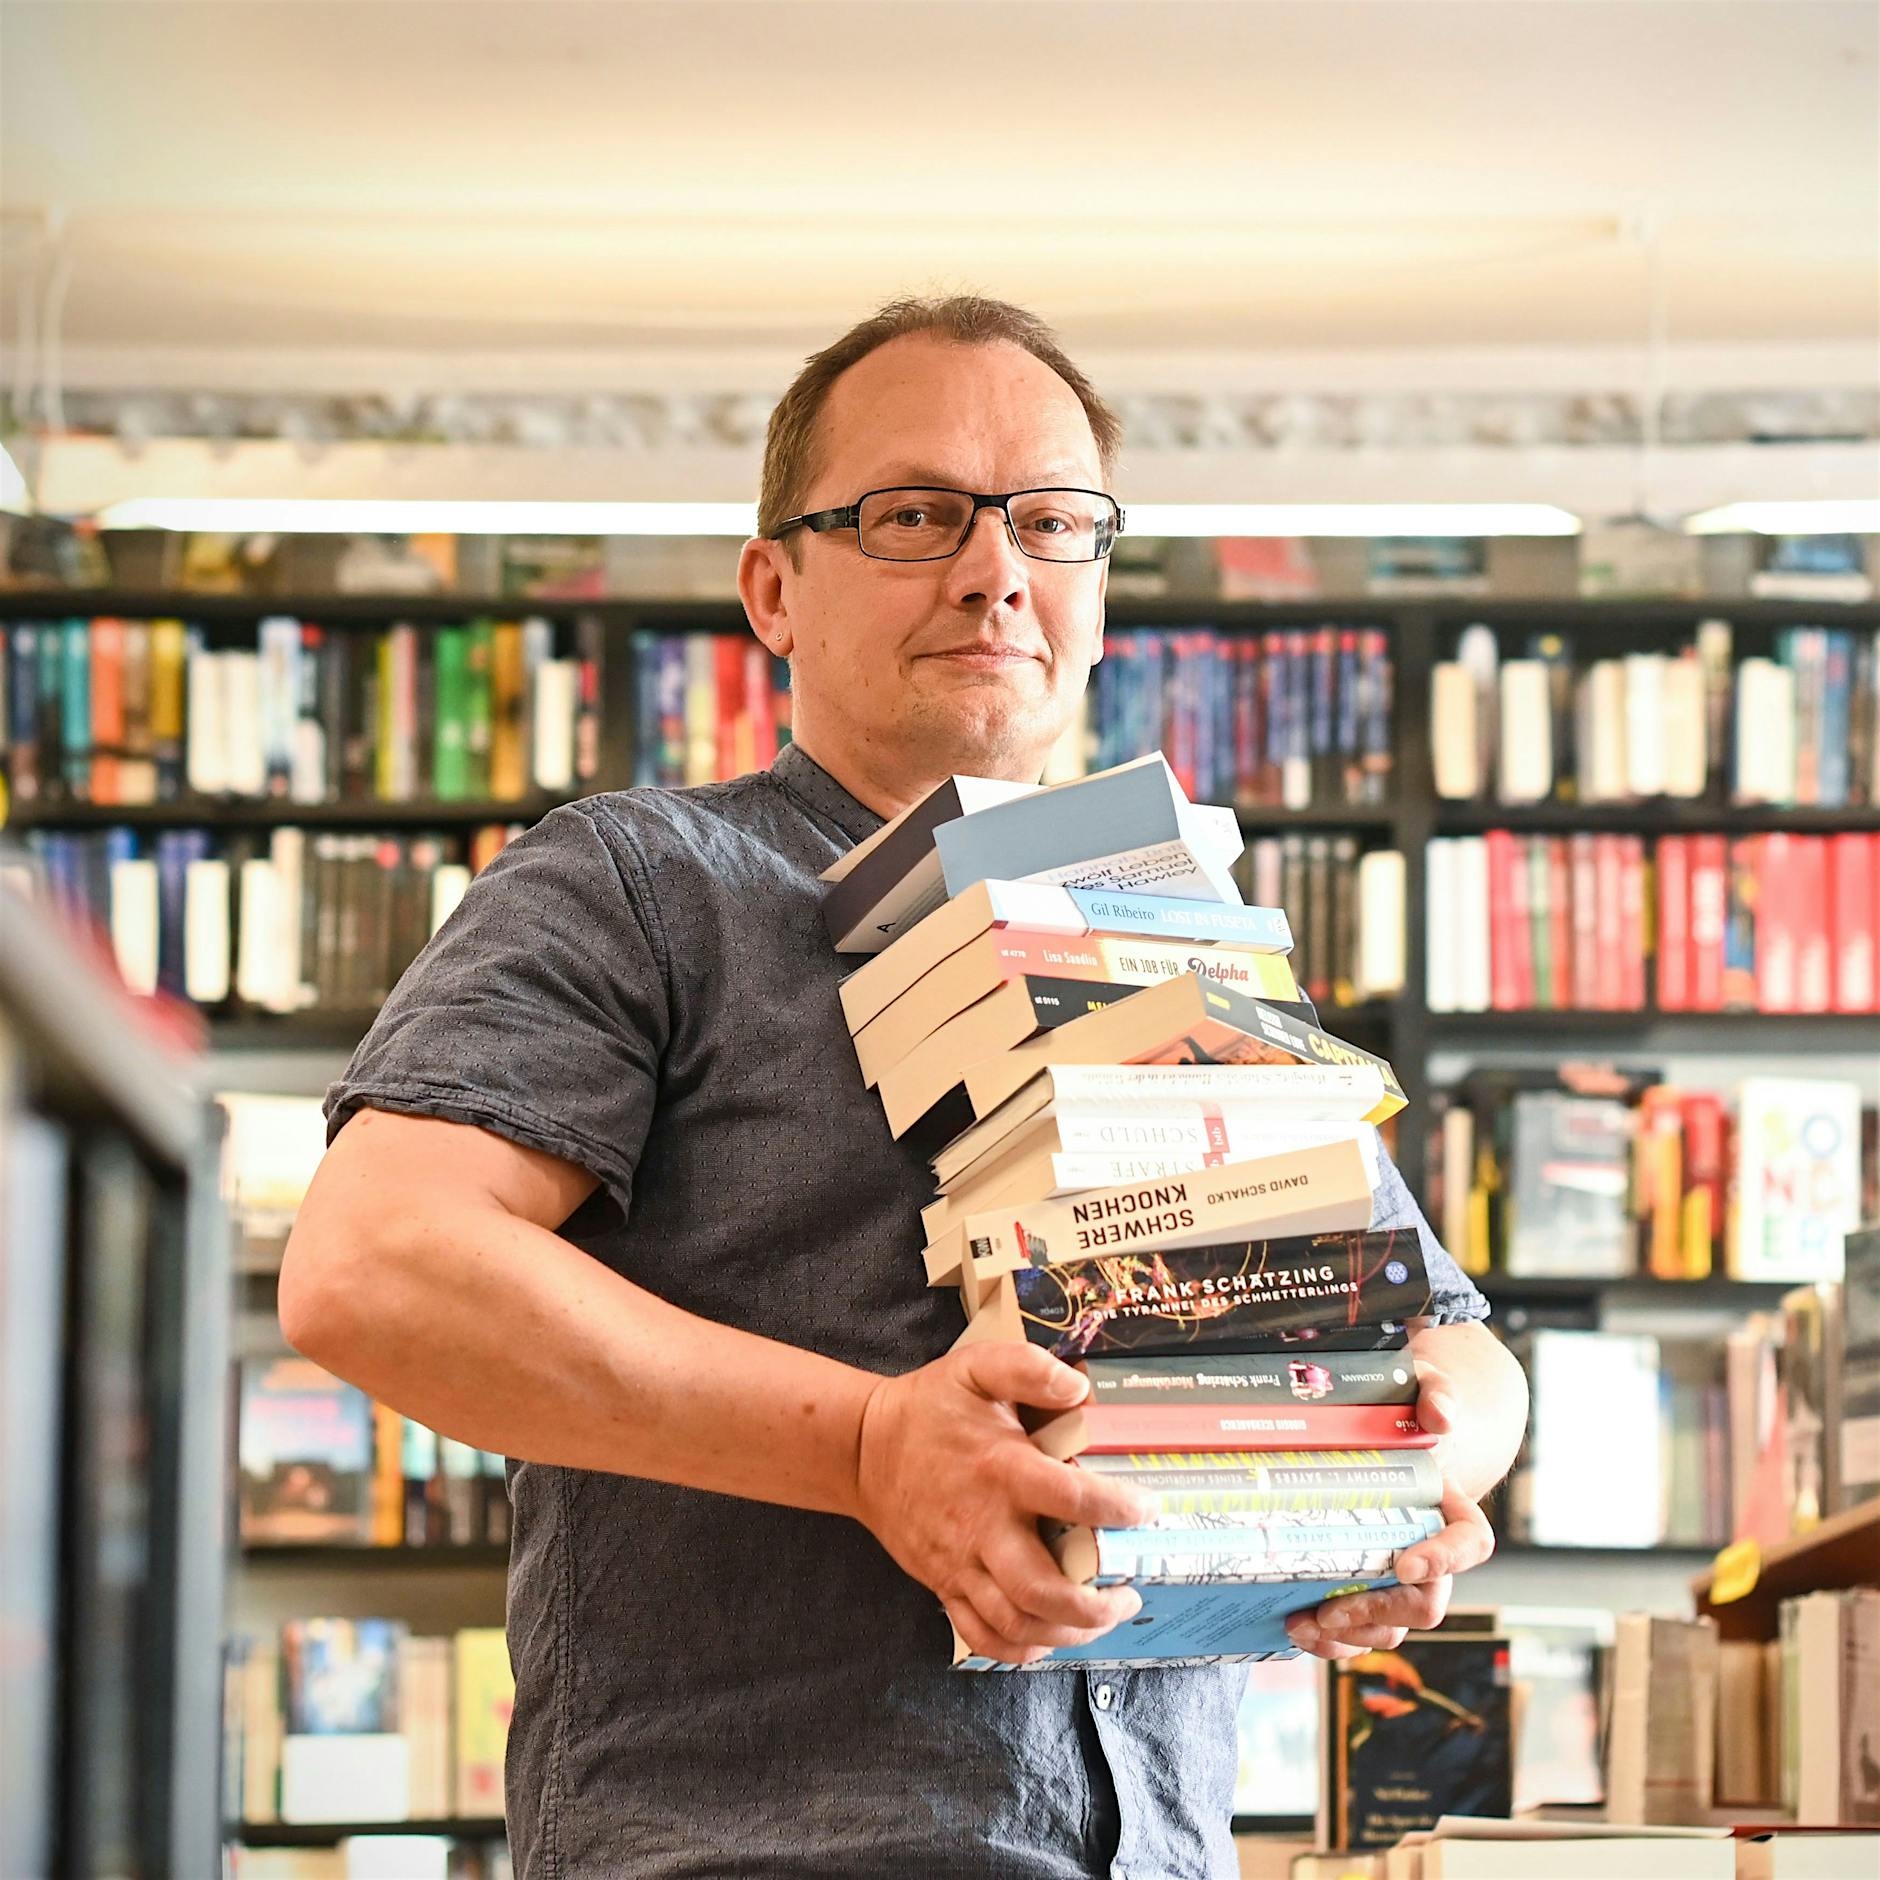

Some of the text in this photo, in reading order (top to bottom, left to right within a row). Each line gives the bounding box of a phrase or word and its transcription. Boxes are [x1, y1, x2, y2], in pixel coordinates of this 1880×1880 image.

[1058, 851, 1188, 889] zwölf Leben
[1108, 858, 1193, 883] Samuel
[1118, 866, 1198, 891] Hawley
[1090, 902, 1110, 918] Gil
[1112, 904, 1155, 922] Ribeiro
[1042, 950, 1064, 965] Lisa
[1064, 952, 1098, 968] Sandlin
[1119, 956, 1249, 986] EIN JOB FÜR Delpha
[1100, 1127, 1199, 1144] SCHULD
[1109, 1160, 1195, 1179] STRAFE
[1207, 1174, 1309, 1206] DAVID SCHALKO
[1071, 1183, 1187, 1224] KNOCHEN
[1075, 1208, 1195, 1250] SCHWERE
[1116, 1264, 1336, 1304] FRANK SCHÄTZING
[1092, 1280, 1360, 1323] DIE TYRANNEI DES SCHMETTERLINGS
[1196, 1372, 1248, 1388] Schätzing
[1250, 1373, 1281, 1388] Frank
[1340, 1372, 1385, 1383] GOLDMANN
[1274, 1470, 1407, 1484] DOROTHY L. SAYERS
[1285, 1533, 1333, 1544] SAYERS
[1357, 1530, 1416, 1541] DOROTHY
